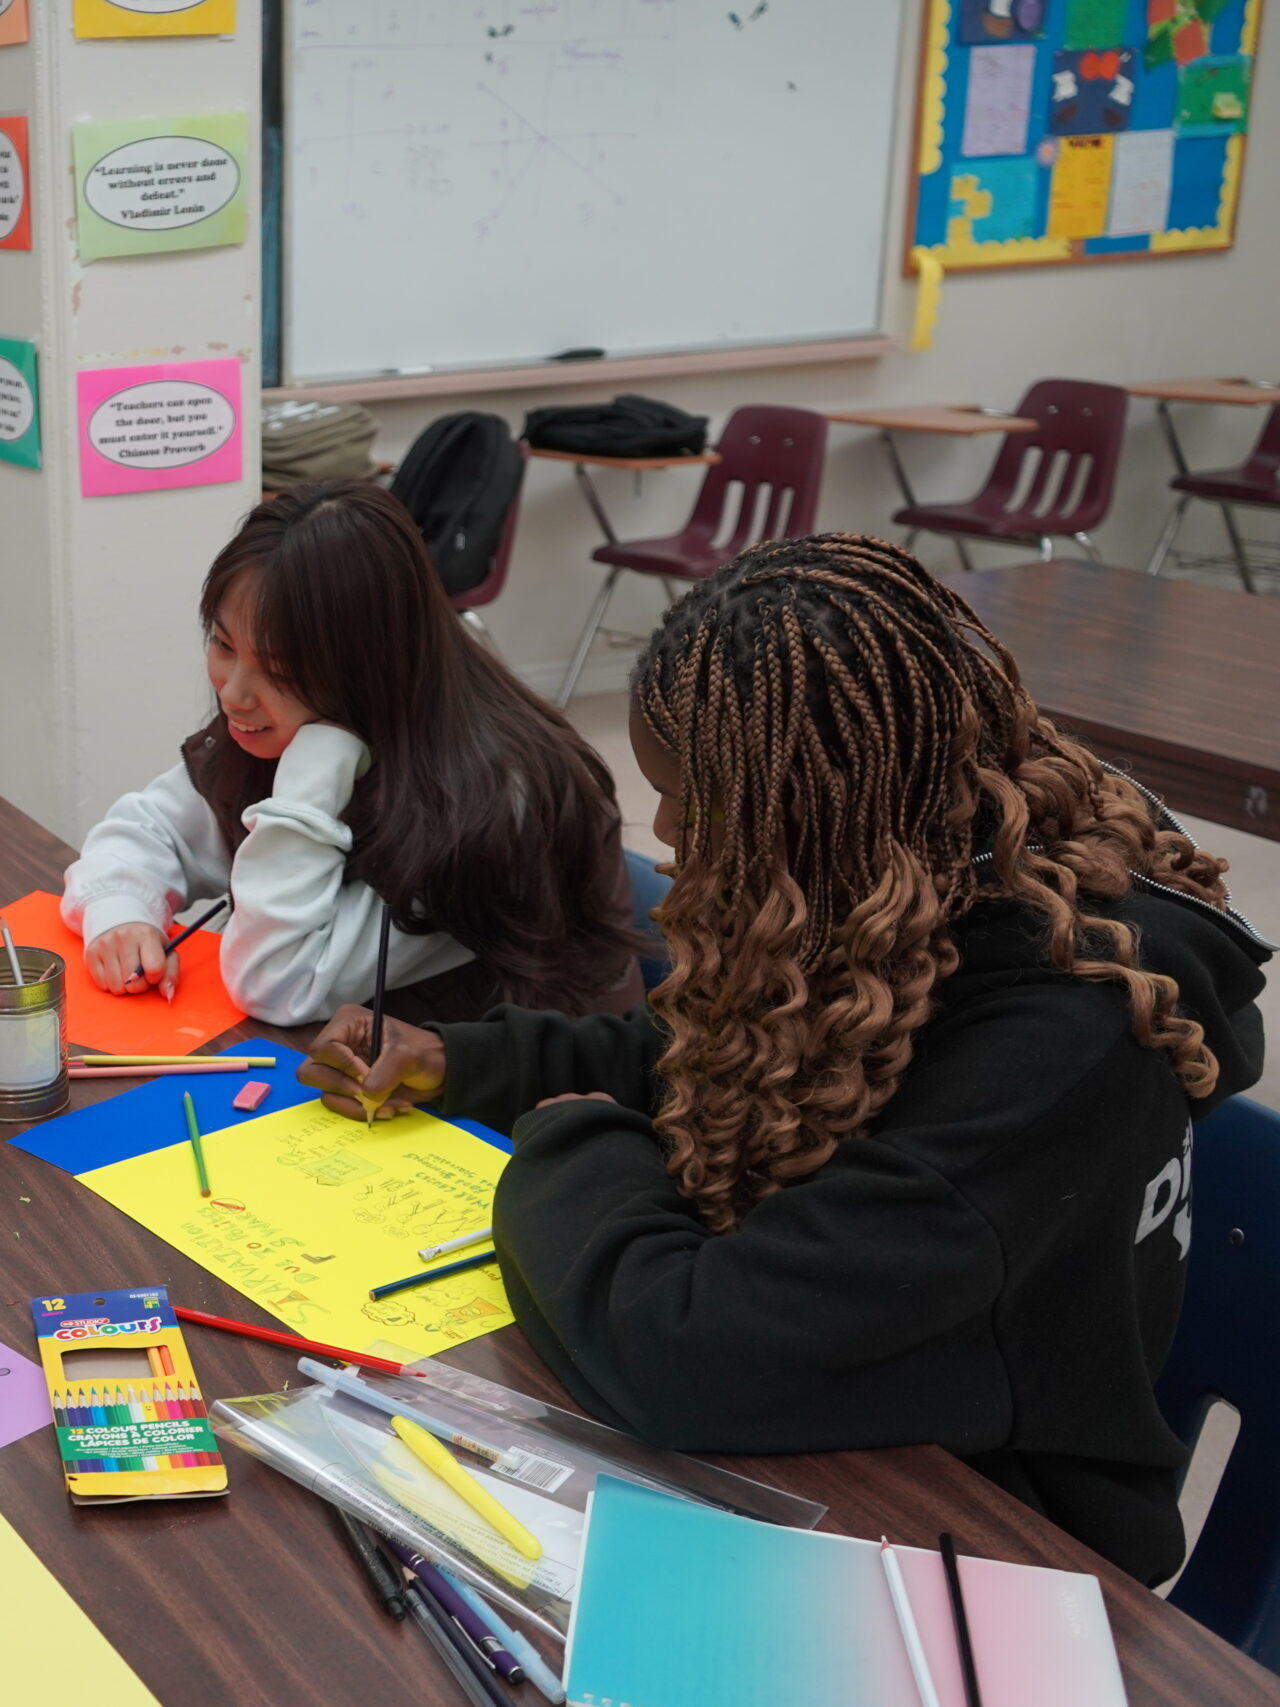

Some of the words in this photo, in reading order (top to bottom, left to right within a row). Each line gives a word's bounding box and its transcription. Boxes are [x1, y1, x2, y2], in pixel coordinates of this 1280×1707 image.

[107, 176, 156, 190] without
[157, 176, 193, 186] errors
[195, 171, 217, 182] and
[120, 207, 172, 220] Vladimir
[167, 414, 186, 424] but
[187, 413, 208, 424] you
[98, 434, 127, 446] must
[129, 432, 158, 443] enter
[117, 447, 161, 459] Chinese
[41, 1297, 67, 1312] 12
[67, 1433, 129, 1442] CRAYONS
[143, 1426, 204, 1437] COLORIER
[69, 1427, 85, 1436] 12
[85, 1424, 138, 1435] COLOUR
[140, 1420, 190, 1431] PENCILS
[132, 1437, 149, 1445] DE
[151, 1433, 196, 1444] COLOR
